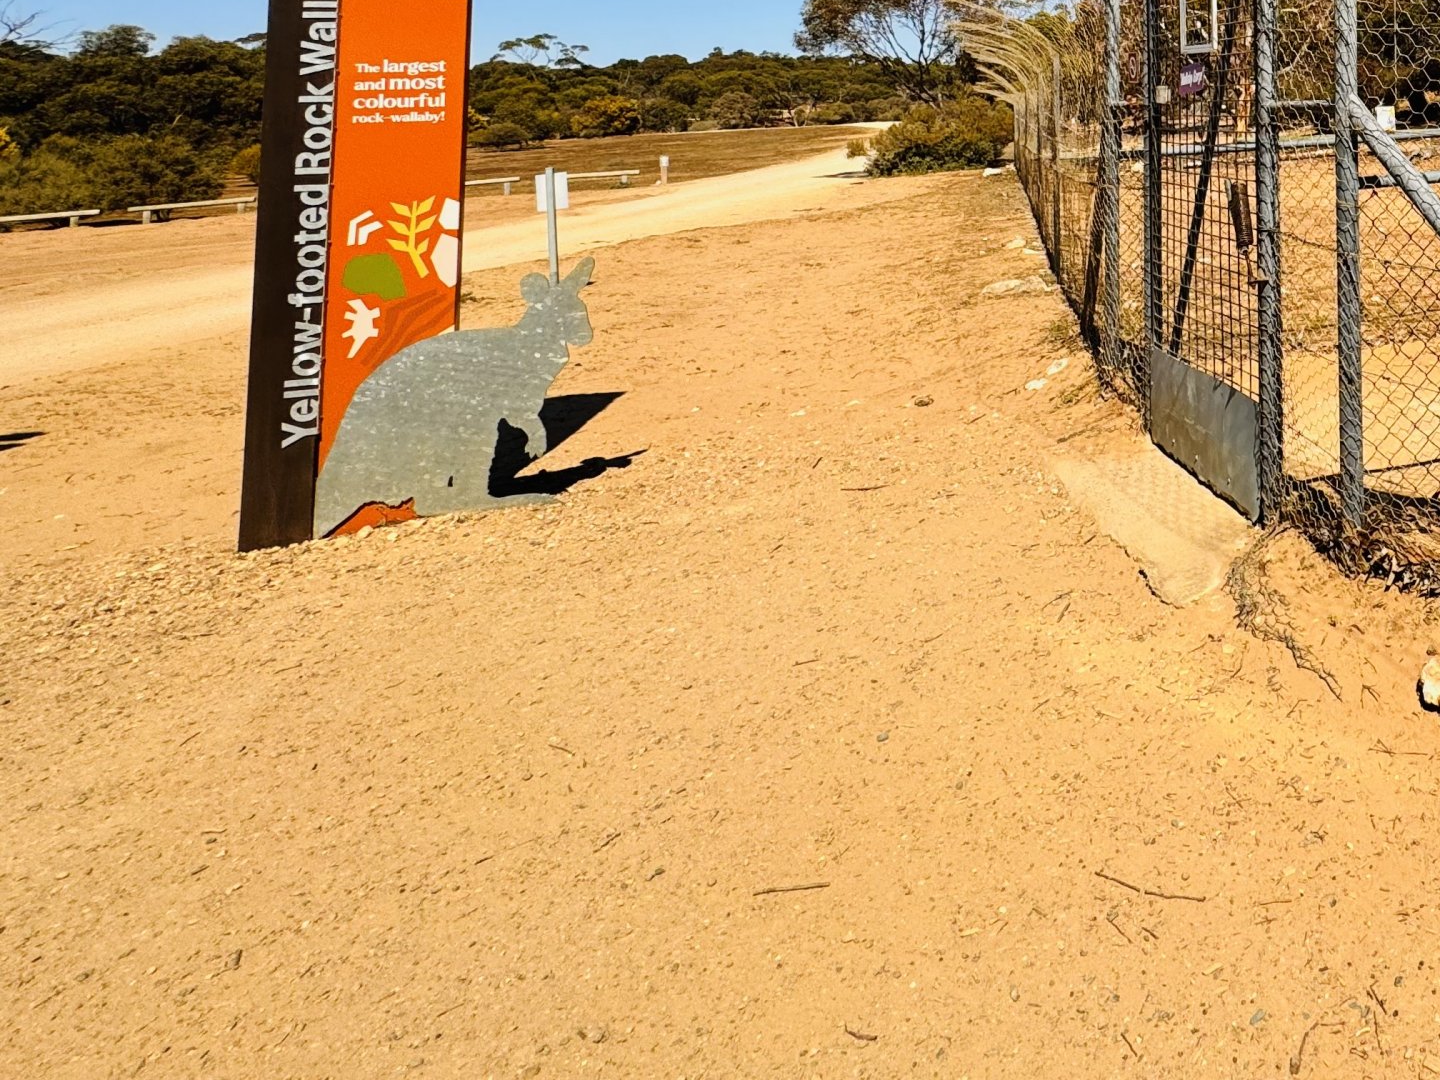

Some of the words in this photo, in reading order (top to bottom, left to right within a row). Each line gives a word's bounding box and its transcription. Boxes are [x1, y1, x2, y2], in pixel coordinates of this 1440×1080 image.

[355, 63, 380, 73] The
[383, 59, 447, 75] largest
[354, 78, 386, 91] and
[389, 75, 446, 90] most
[353, 92, 446, 109] colourful
[352, 111, 445, 124] rock-wallaby!
[294, 81, 335, 176] Rock
[281, 184, 330, 449] Yellow-footed
